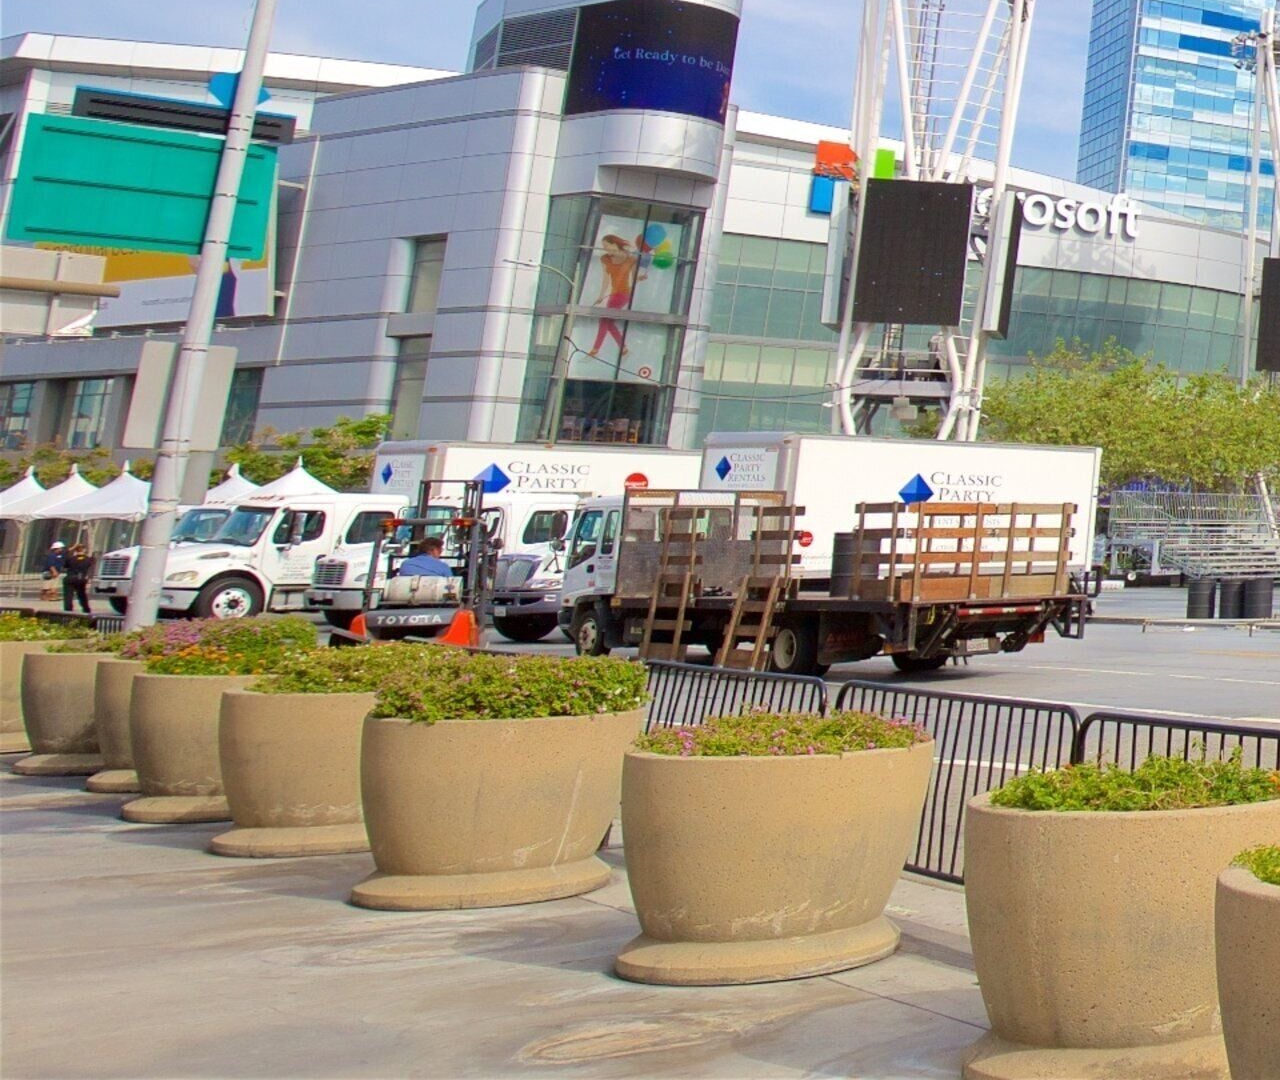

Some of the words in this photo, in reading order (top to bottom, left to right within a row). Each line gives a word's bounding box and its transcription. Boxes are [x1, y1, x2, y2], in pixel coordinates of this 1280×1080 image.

[635, 48, 678, 66] Ready
[682, 55, 696, 65] to
[699, 55, 714, 69] be
[507, 460, 590, 475] CLASSIC
[517, 475, 582, 489] PARTY
[931, 471, 1003, 487] CLASSIC
[938, 487, 996, 502] PARTY
[376, 614, 442, 625] TOYOTA
